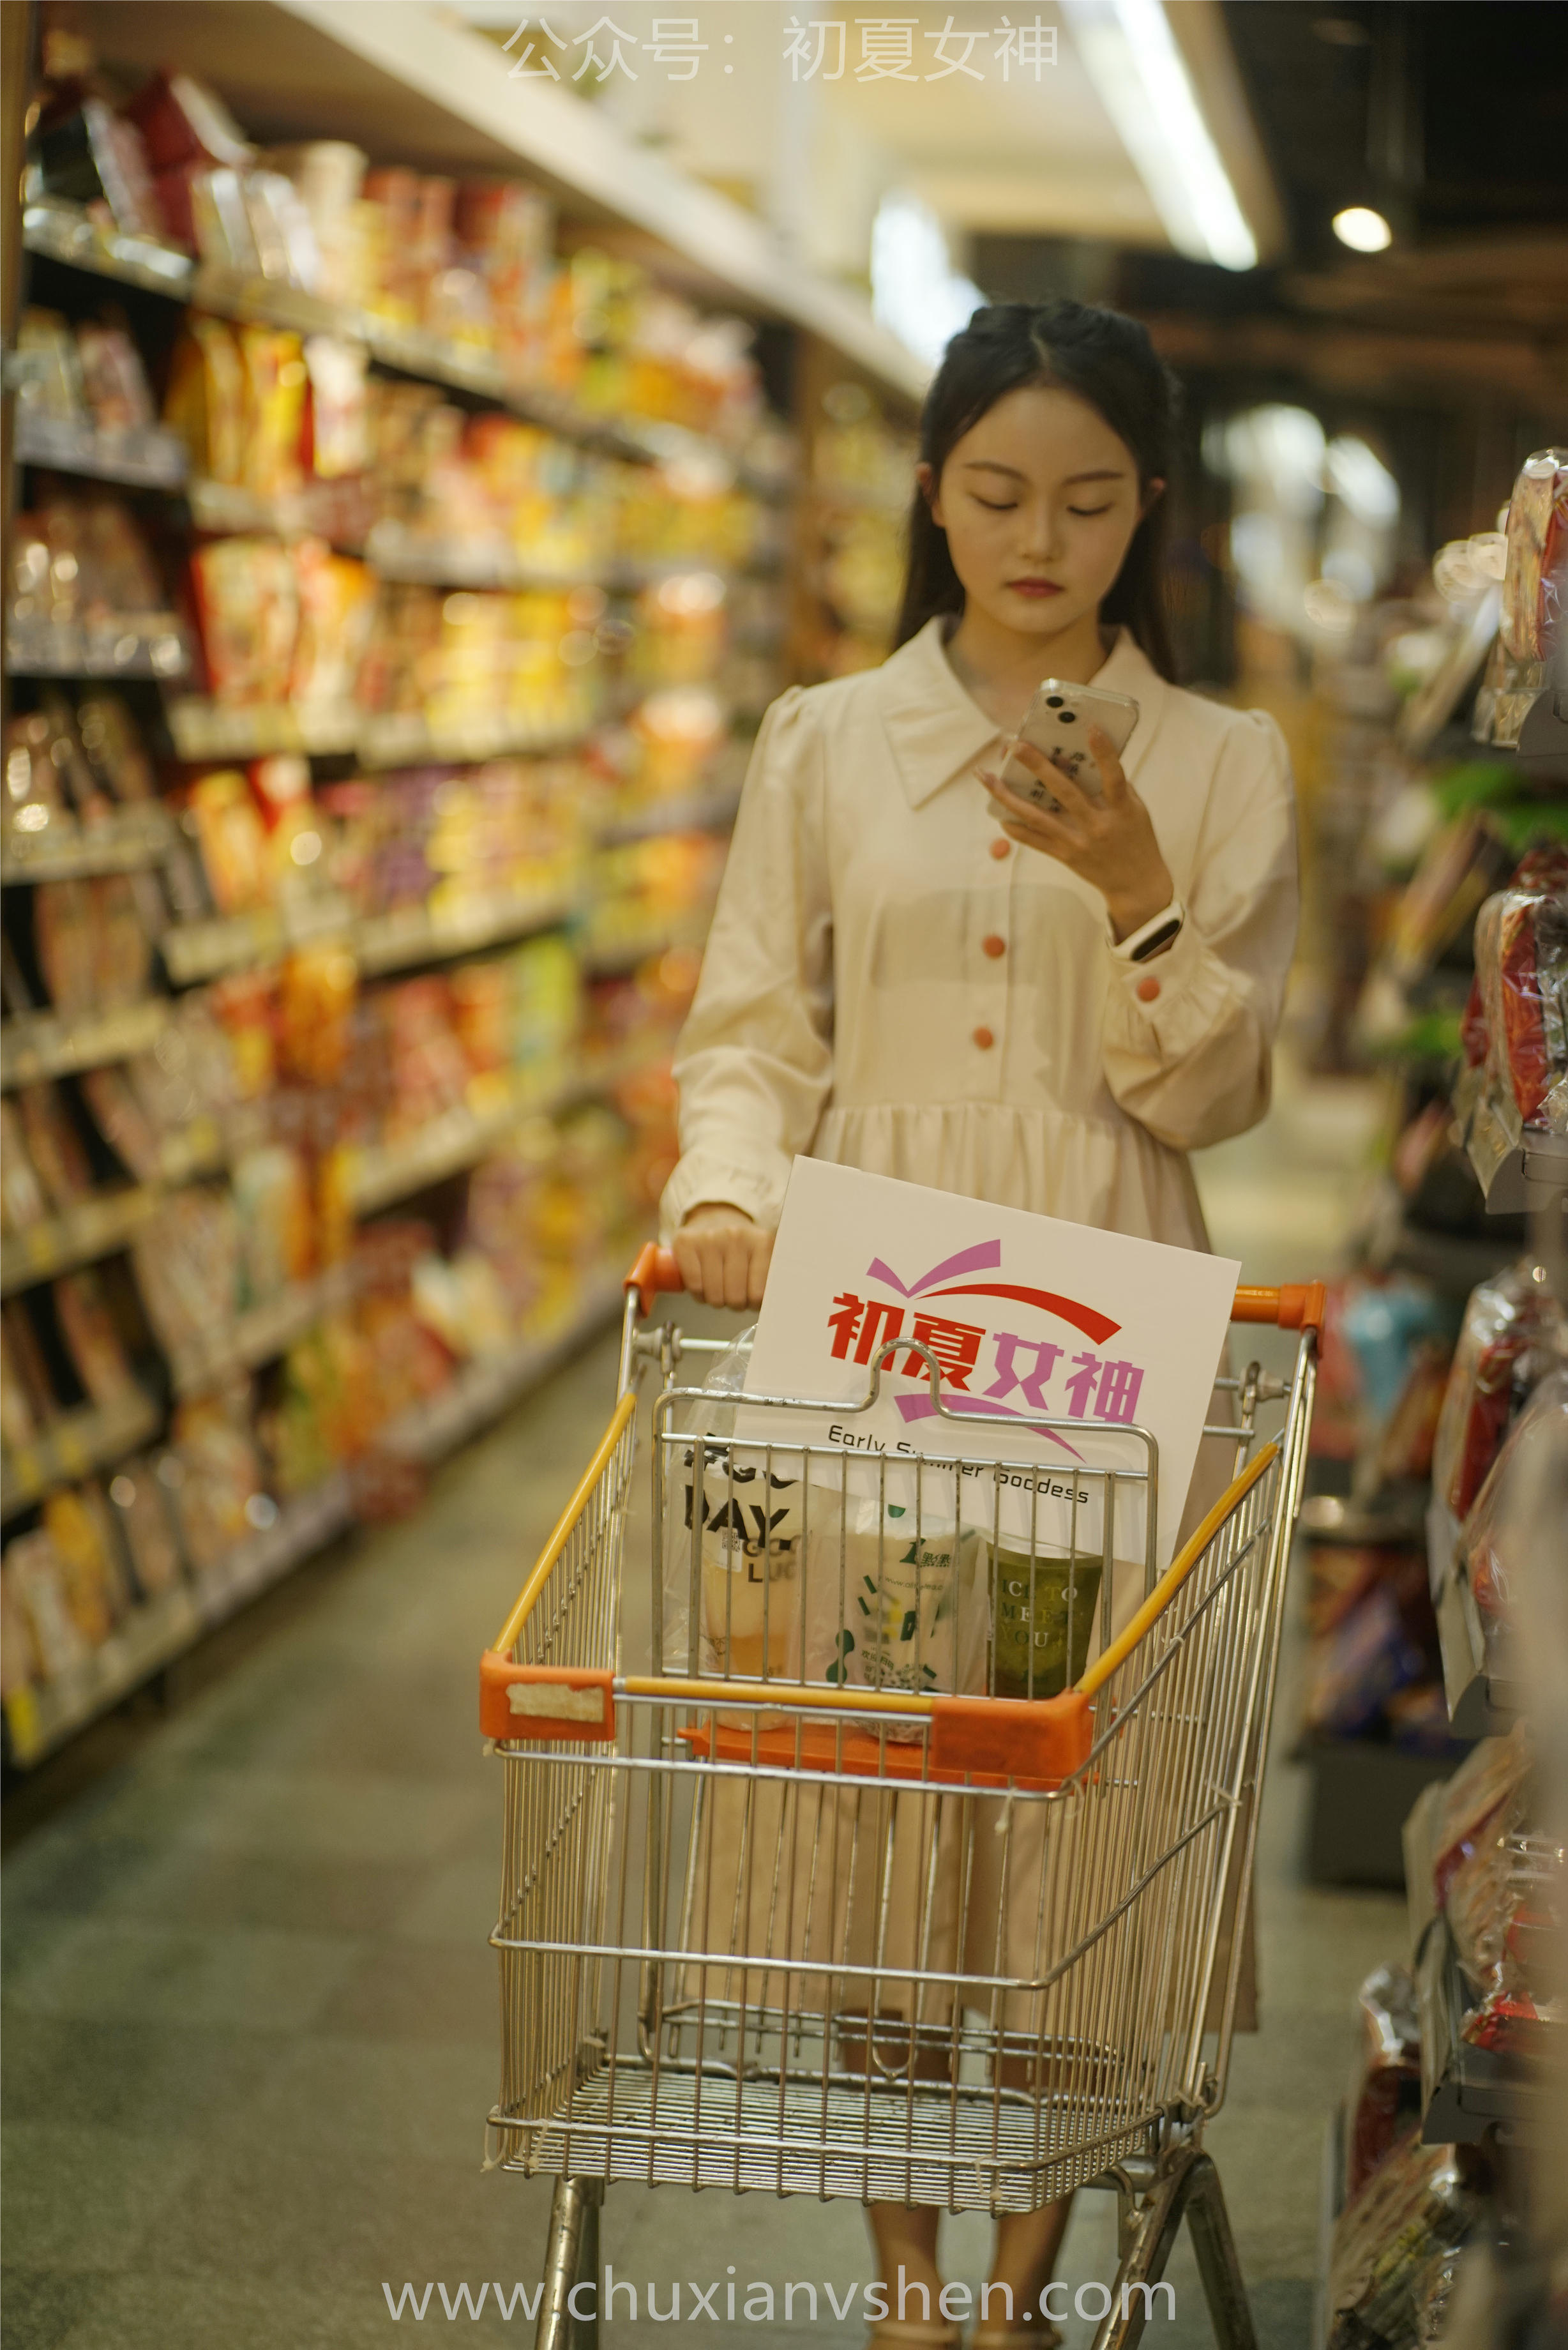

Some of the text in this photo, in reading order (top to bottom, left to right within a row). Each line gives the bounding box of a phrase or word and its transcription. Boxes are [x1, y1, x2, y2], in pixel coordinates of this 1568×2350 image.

[827, 1292, 1144, 1423] 初夏女神
[829, 1425, 886, 1452] Early
